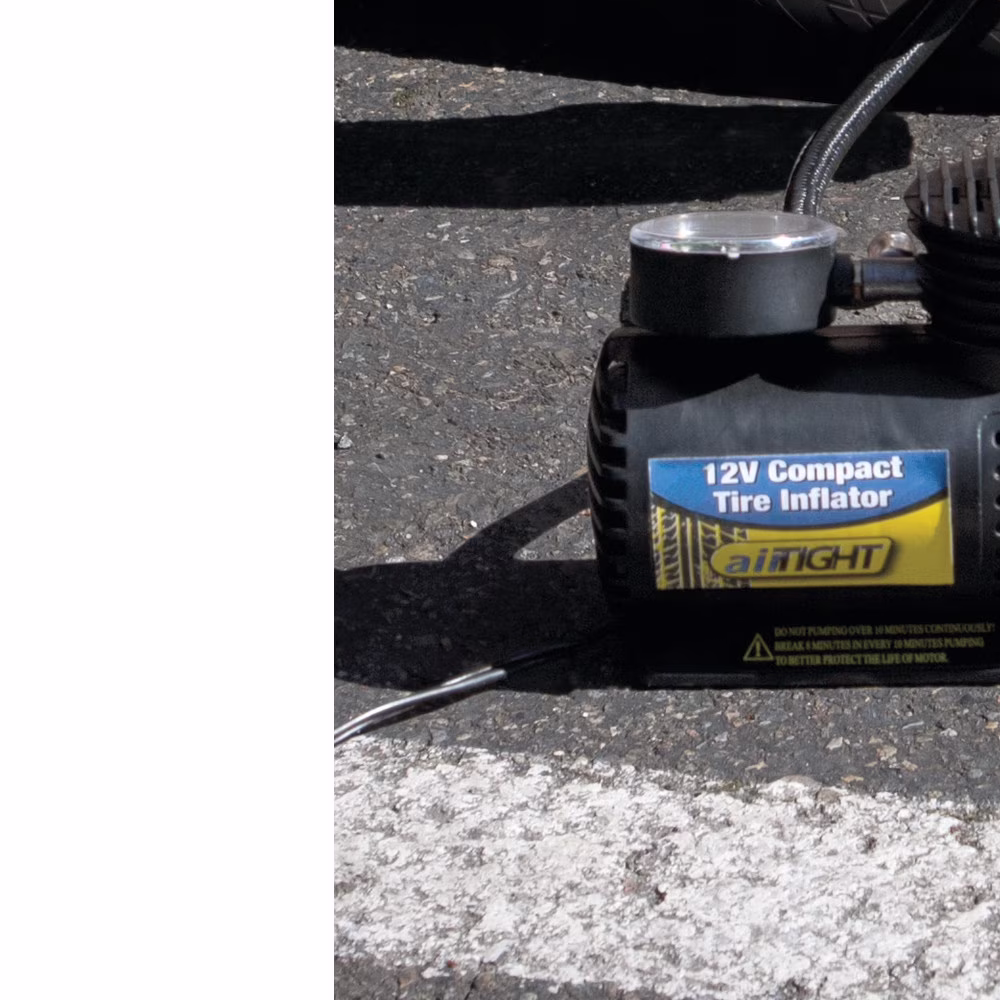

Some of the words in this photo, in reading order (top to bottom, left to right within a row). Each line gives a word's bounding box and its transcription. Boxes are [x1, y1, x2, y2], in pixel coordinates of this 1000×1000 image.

[703, 459, 760, 486] 12V
[767, 455, 904, 486] Compact
[713, 490, 771, 513] Tire
[780, 486, 894, 512] Inflator
[774, 627, 787, 637] DO
[789, 627, 806, 636] NOT
[808, 626, 847, 636] PUMPING
[885, 624, 923, 634] MINUTES
[774, 641, 804, 651] BREAK
[811, 640, 851, 650] MINUTES
[853, 640, 862, 649] IN
[864, 639, 892, 649] EVERY
[904, 638, 943, 648] MINUTES
[945, 637, 984, 647] PUMPING
[775, 655, 787, 665] TO
[789, 655, 821, 665] BETTER
[823, 654, 864, 665] PROTECT
[864, 654, 880, 664] THE
[882, 653, 900, 664] LIFE
[901, 653, 913, 663] OF
